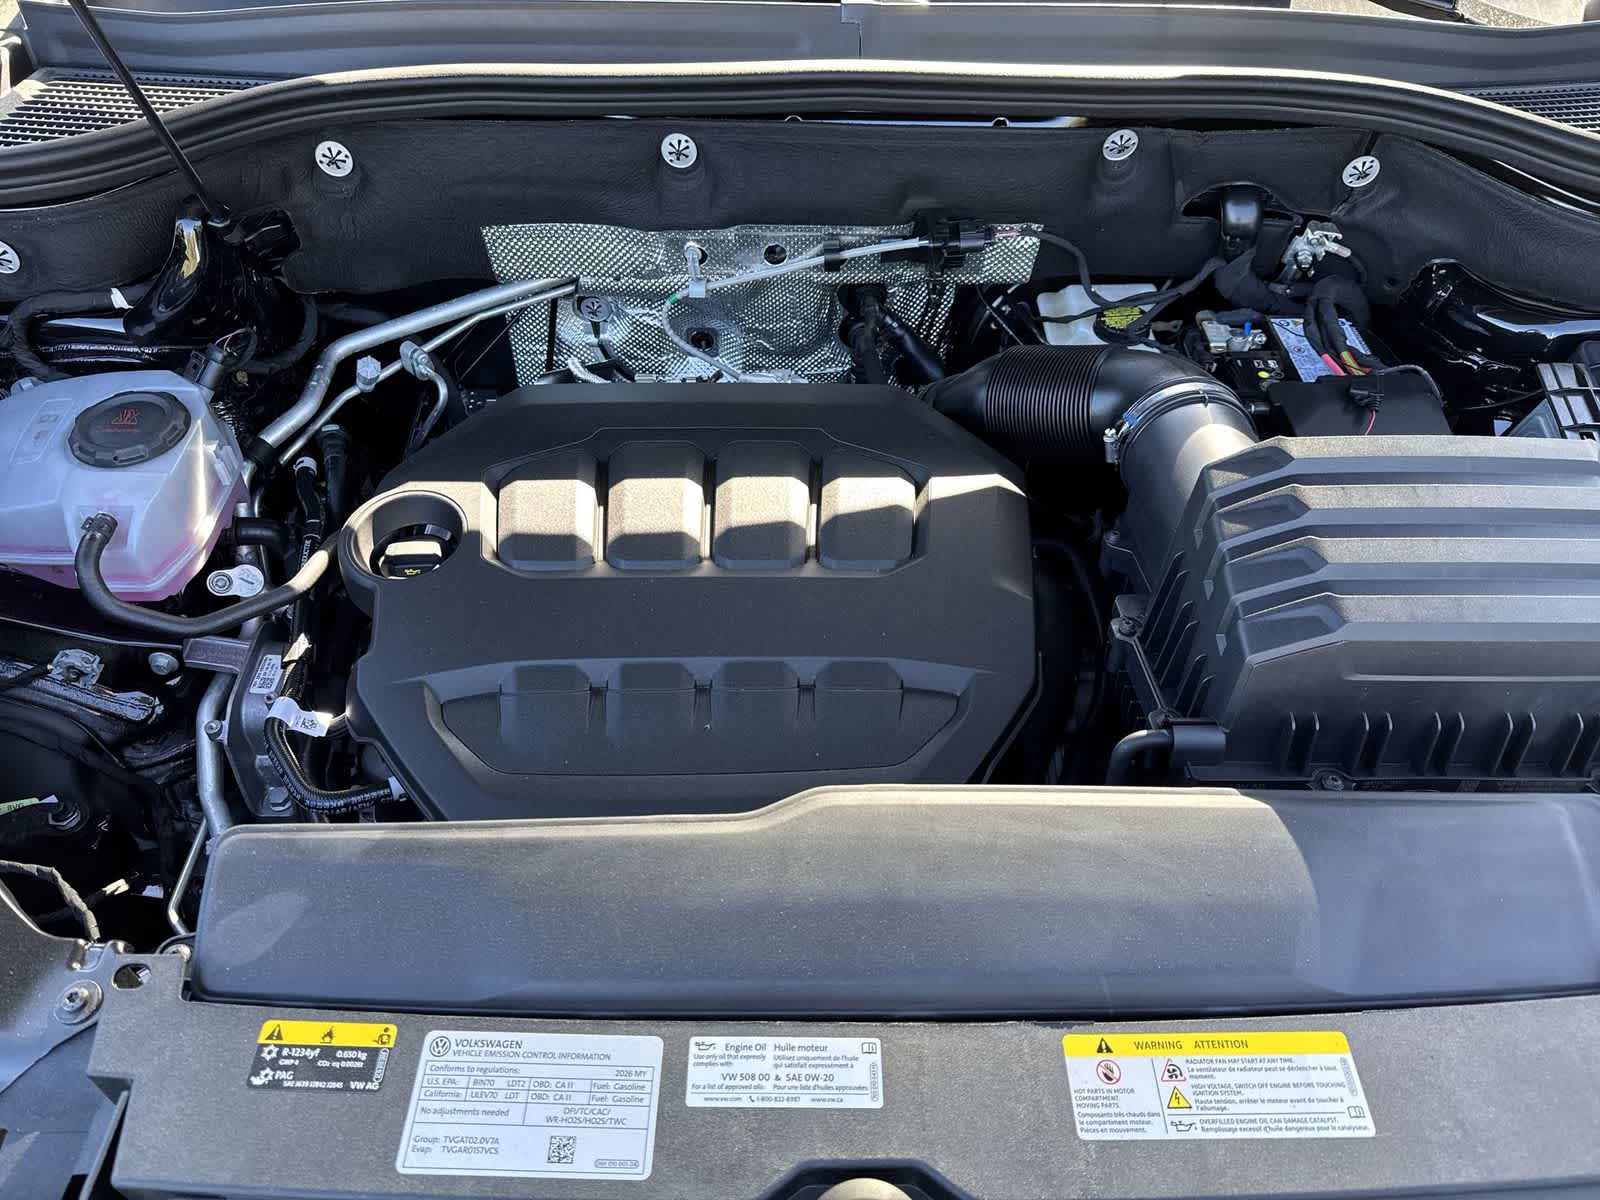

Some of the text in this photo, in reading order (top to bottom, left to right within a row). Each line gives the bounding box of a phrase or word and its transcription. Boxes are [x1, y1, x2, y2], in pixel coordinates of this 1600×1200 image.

[454, 1039, 523, 1049] VOLKSWAGEN
[724, 1042, 767, 1054] Engine Oil
[774, 1043, 828, 1052] Huile moteur
[1134, 1040, 1249, 1050] WARNING ATTENTION
[282, 1048, 320, 1060] R-1234yf
[358, 1050, 368, 1060] kg
[483, 1050, 520, 1058] EMISSION
[522, 1051, 556, 1060] CONTROL
[558, 1052, 612, 1061] INFORMATION
[430, 1064, 466, 1073] Conforms
[476, 1066, 521, 1075] regulations:
[616, 1070, 647, 1078] 2026 MY
[274, 1070, 294, 1080] PAG
[721, 1072, 834, 1082] VW 508 00 & SAE 0W-20
[350, 1081, 366, 1090] VW
[366, 1082, 380, 1090] AG
[506, 1080, 526, 1088] LDT2
[533, 1080, 552, 1089] OBD:
[555, 1081, 566, 1089] CA
[593, 1082, 610, 1090] Fuel:
[613, 1083, 646, 1091] Gasoline
[424, 1090, 464, 1098] California:
[504, 1092, 520, 1100] LDT
[553, 1093, 564, 1101] CA
[592, 1094, 610, 1102] Fuel:
[612, 1095, 644, 1103] Gasoline
[421, 1106, 510, 1117] No adjustments needed
